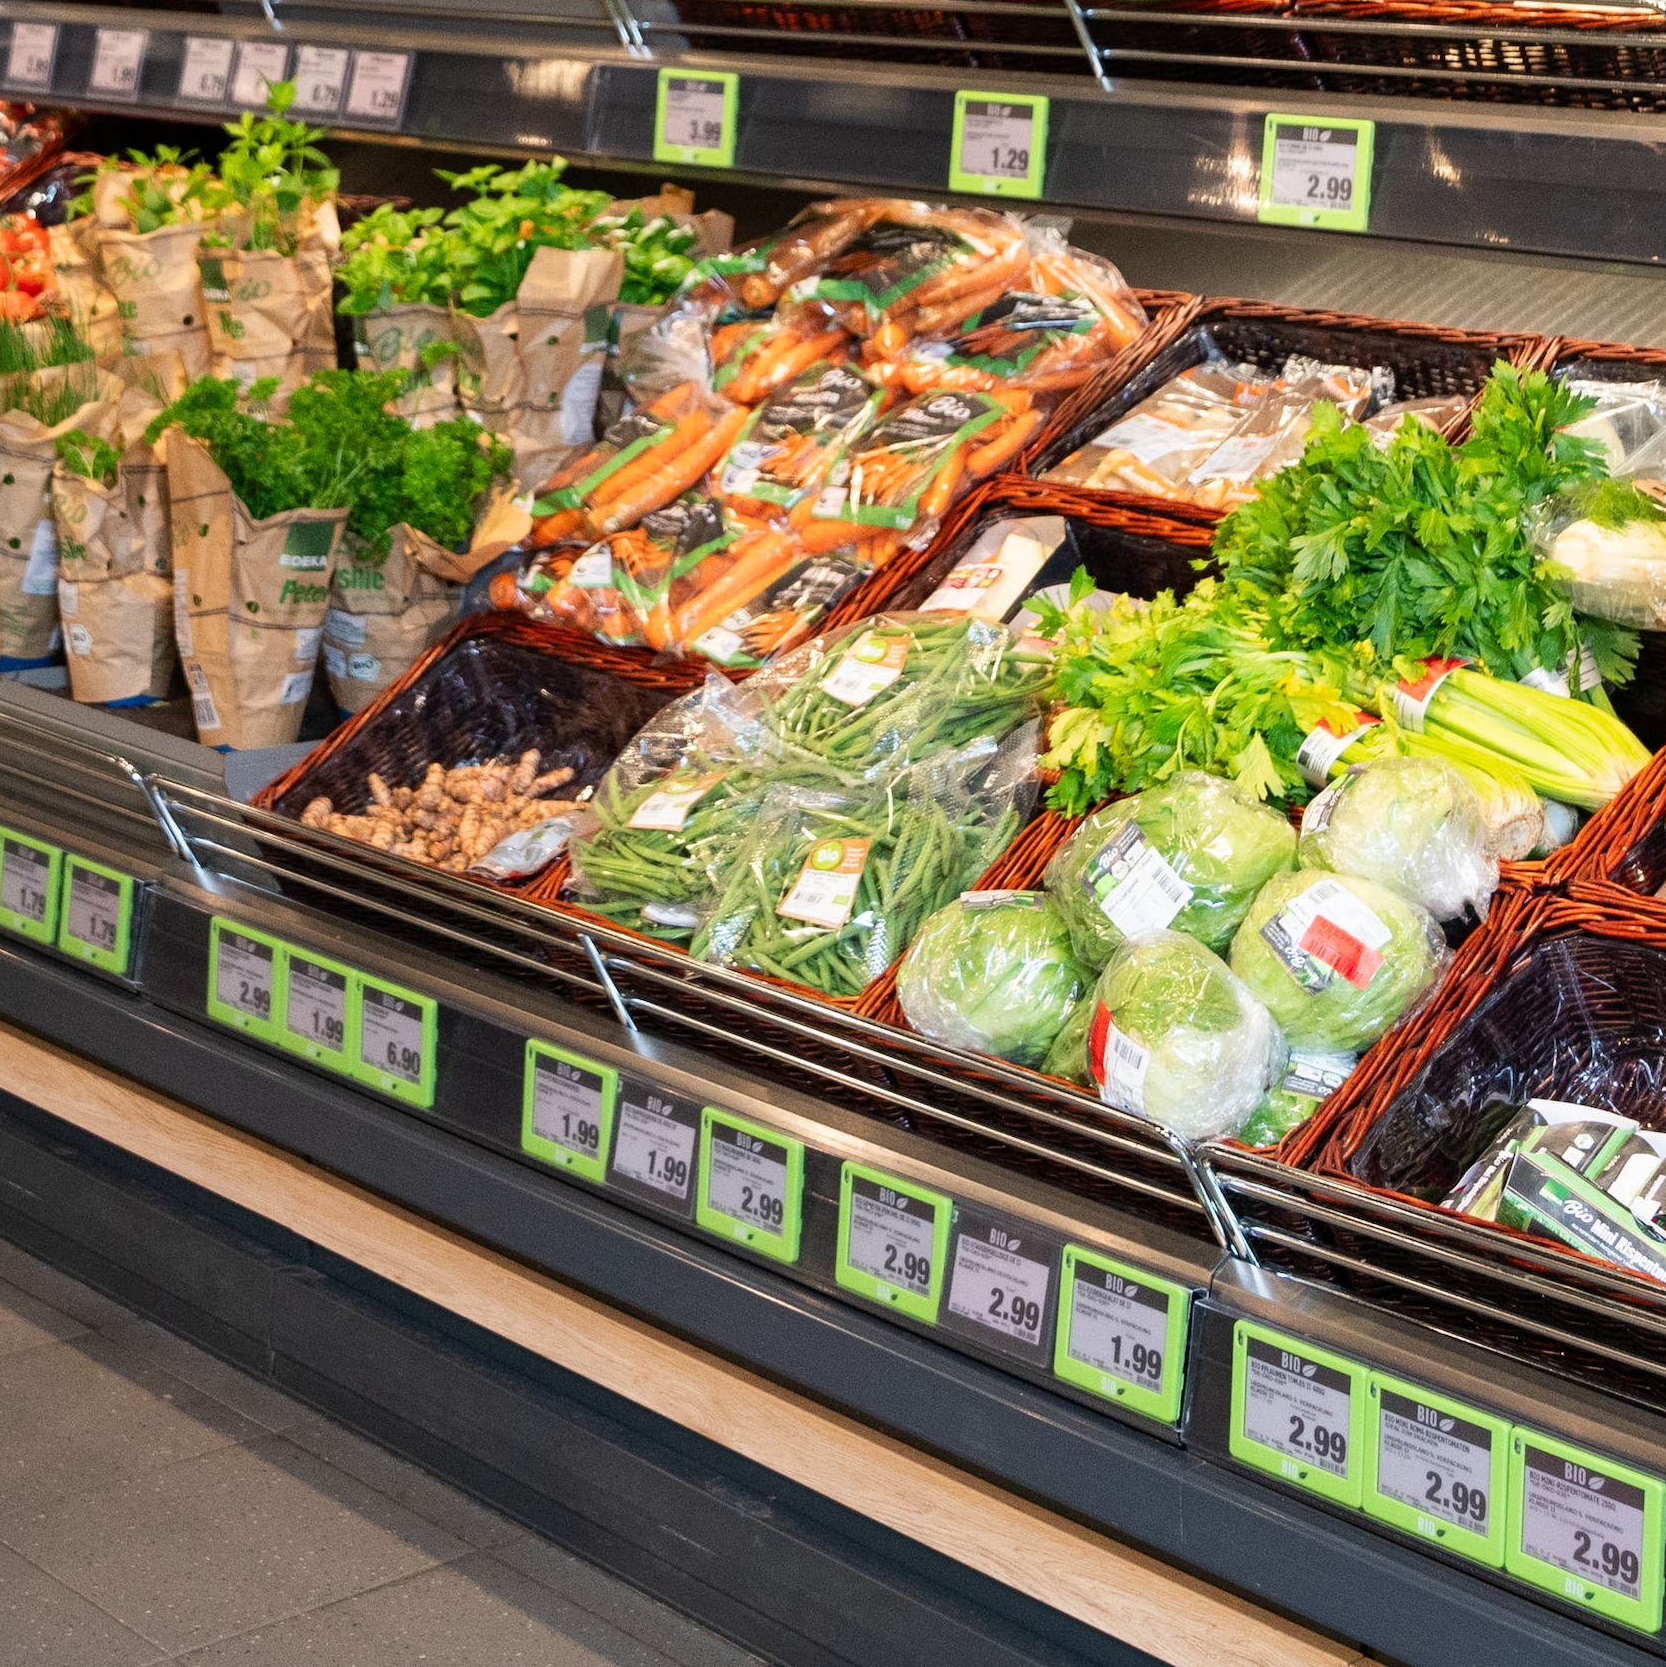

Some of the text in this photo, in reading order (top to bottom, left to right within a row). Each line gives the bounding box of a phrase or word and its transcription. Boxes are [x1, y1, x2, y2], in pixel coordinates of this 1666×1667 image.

[1302, 126, 1319, 141] BIO
[991, 147, 1030, 171] 1.29
[1306, 174, 1353, 201] 2.99
[927, 395, 972, 420] Bio
[279, 552, 329, 570] EDEKA
[817, 849, 839, 863] Bio
[1098, 846, 1119, 869] Bio
[239, 981, 271, 1013] 2.99
[312, 1010, 344, 1043] 1.99
[386, 1041, 421, 1076] 6.90
[647, 1095, 663, 1114] BIO
[561, 1110, 599, 1150] 1.99
[735, 1130, 751, 1150] BIO
[645, 1146, 688, 1189] 1.99
[740, 1183, 784, 1227] 2.99
[878, 1186, 895, 1206] BIO
[1562, 1198, 1596, 1228] Bio
[1589, 1219, 1620, 1249] Mini
[989, 1228, 1008, 1250] BIO
[883, 1241, 930, 1287] 2.99
[1104, 1272, 1123, 1295] BIO
[987, 1284, 1041, 1333] 2.99
[1109, 1331, 1163, 1382] 1.99
[1281, 1350, 1300, 1374] BIO
[1100, 1376, 1118, 1396] BIO
[1416, 1403, 1437, 1428] BIO
[1288, 1412, 1346, 1466] 2.99
[1281, 1459, 1299, 1480] BIO
[1529, 1470, 1540, 1482] BIO
[1563, 1460, 1586, 1487] BIO
[1424, 1468, 1487, 1524] 2.99
[1417, 1515, 1436, 1536] BIO
[1572, 1527, 1639, 1587] 2.99
[1564, 1577, 1584, 1599] BIO
